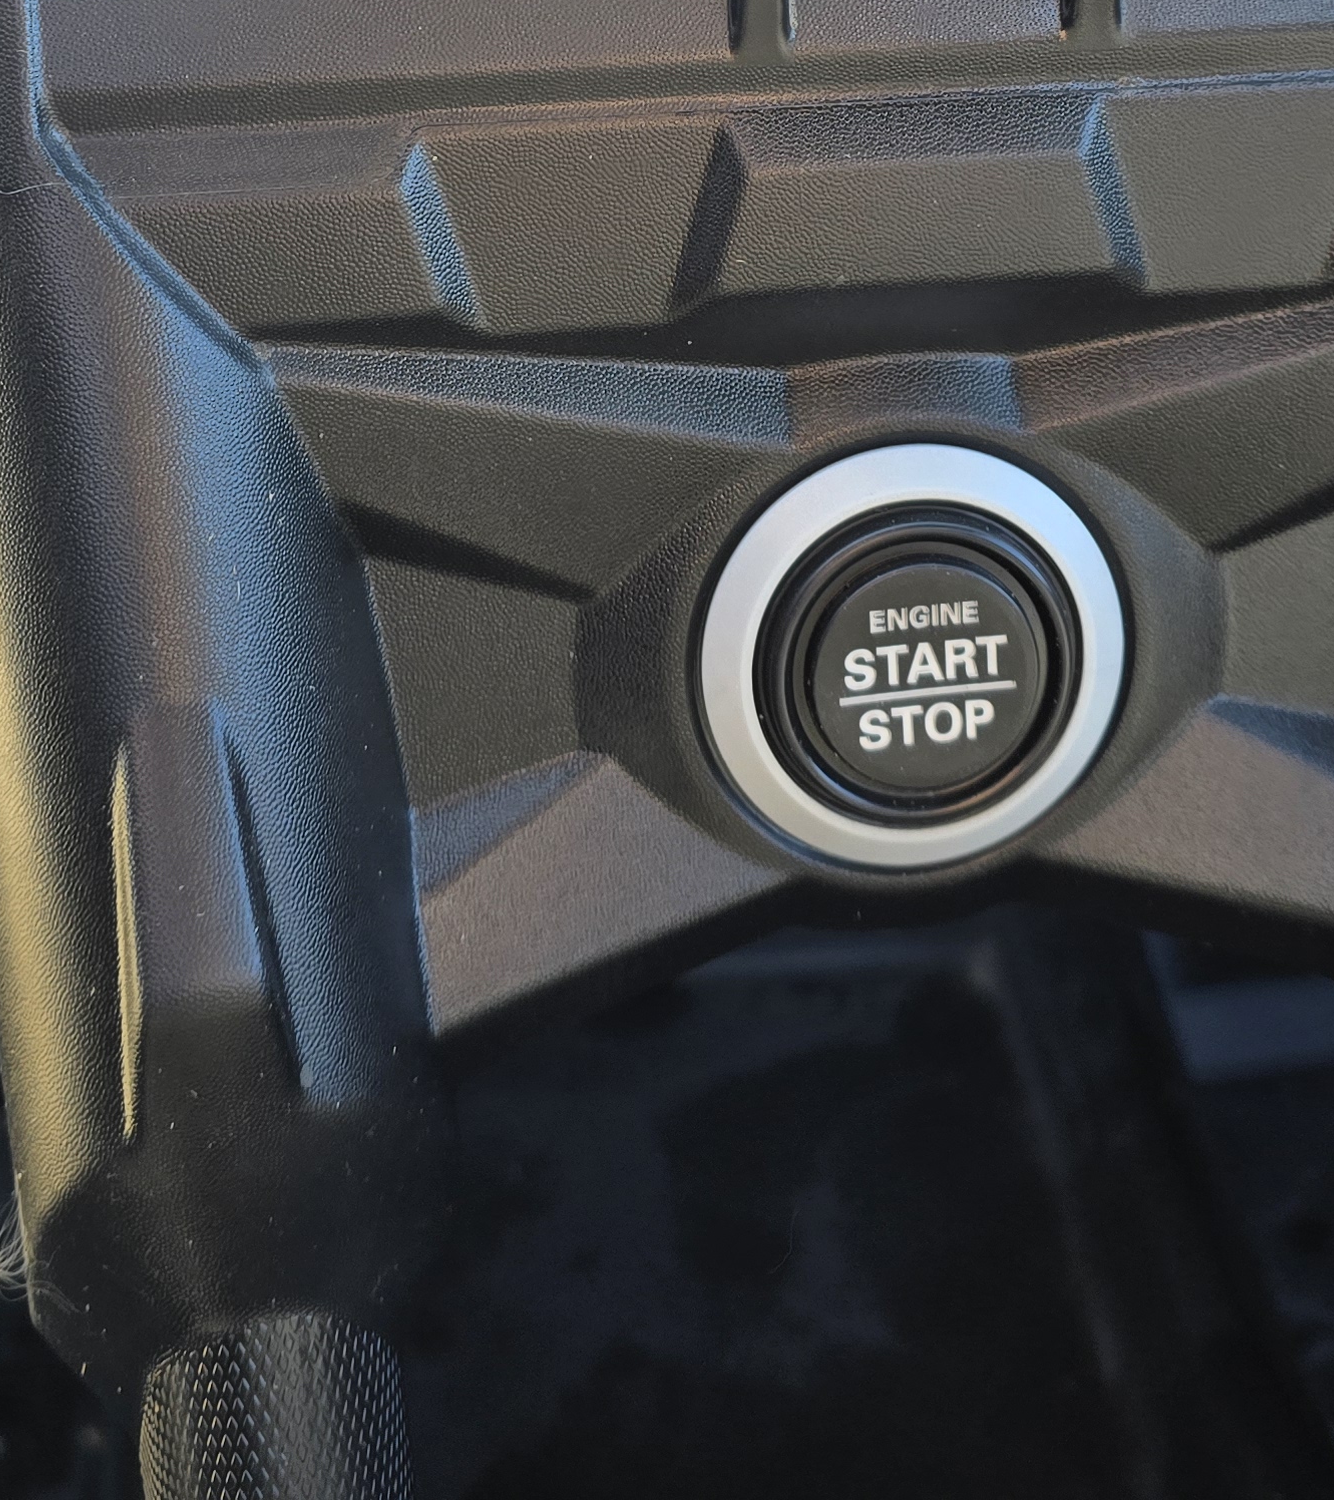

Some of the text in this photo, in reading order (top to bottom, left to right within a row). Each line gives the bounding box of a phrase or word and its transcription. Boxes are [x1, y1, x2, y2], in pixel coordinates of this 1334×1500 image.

[868, 600, 980, 634] ENGINE
[844, 633, 1009, 691] START
[858, 698, 995, 751] STOP
